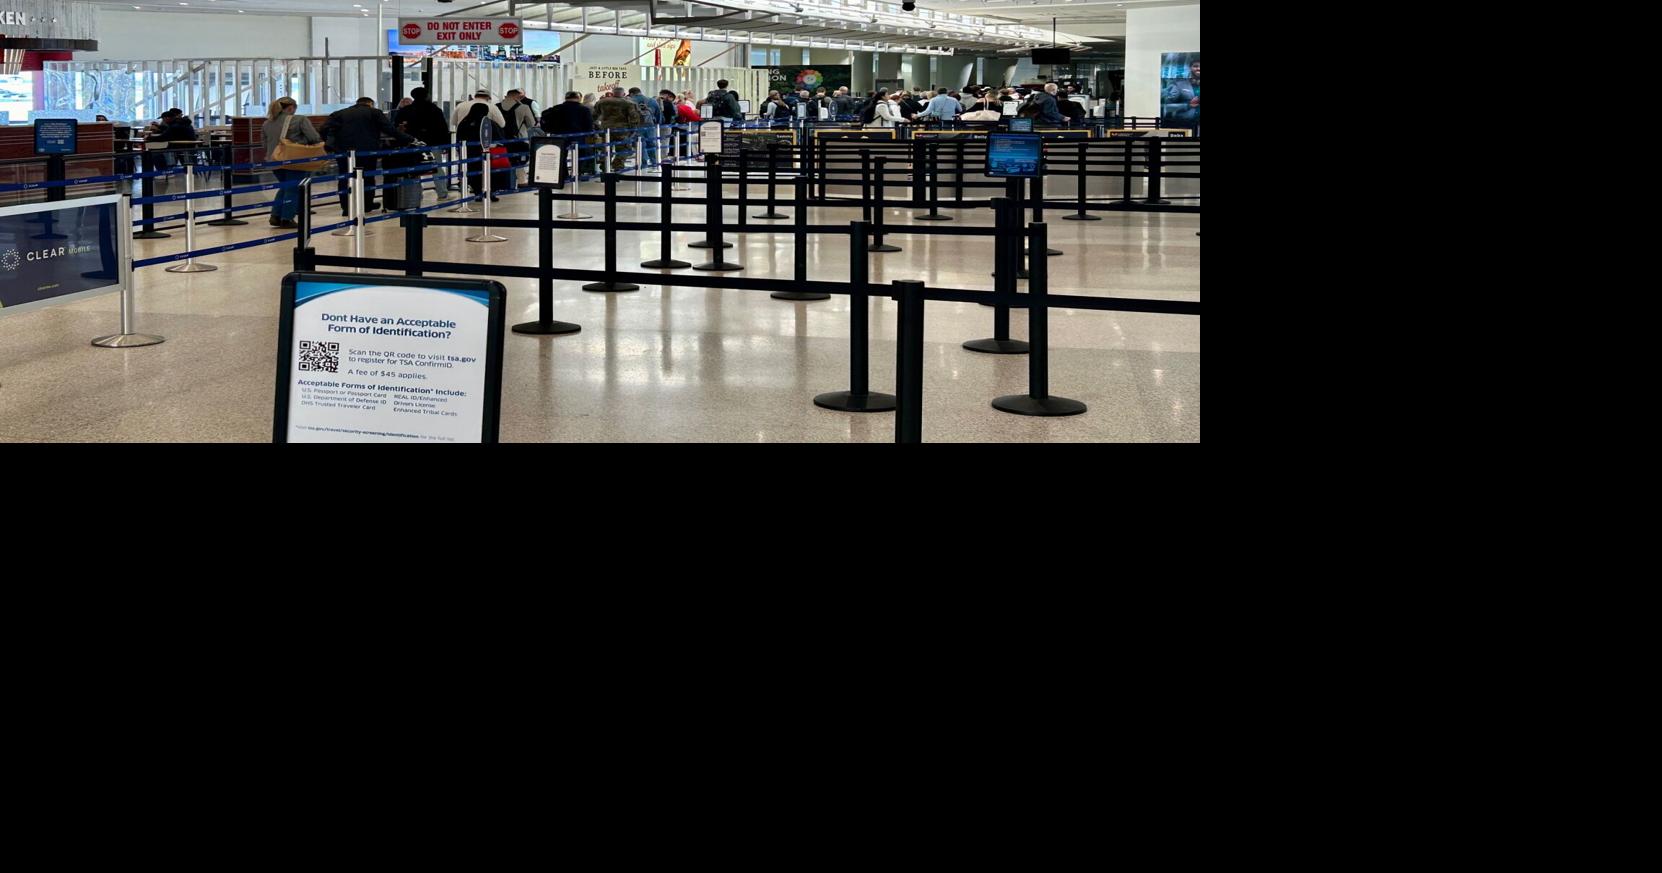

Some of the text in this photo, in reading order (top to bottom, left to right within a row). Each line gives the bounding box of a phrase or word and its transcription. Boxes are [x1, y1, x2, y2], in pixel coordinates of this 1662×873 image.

[427, 22, 492, 30] DO NOT ENTER
[500, 26, 518, 34] STOP
[436, 32, 482, 40] EXIT ONLY
[588, 70, 628, 78] BEFORE
[26, 246, 65, 261] CLEAR
[321, 313, 348, 322] Dont
[350, 315, 378, 324] Have
[396, 317, 456, 328] Acceptable
[328, 324, 356, 333] Form
[373, 327, 452, 339] Identification?
[298, 379, 340, 388] Acceptable
[435, 389, 467, 397] Include:
